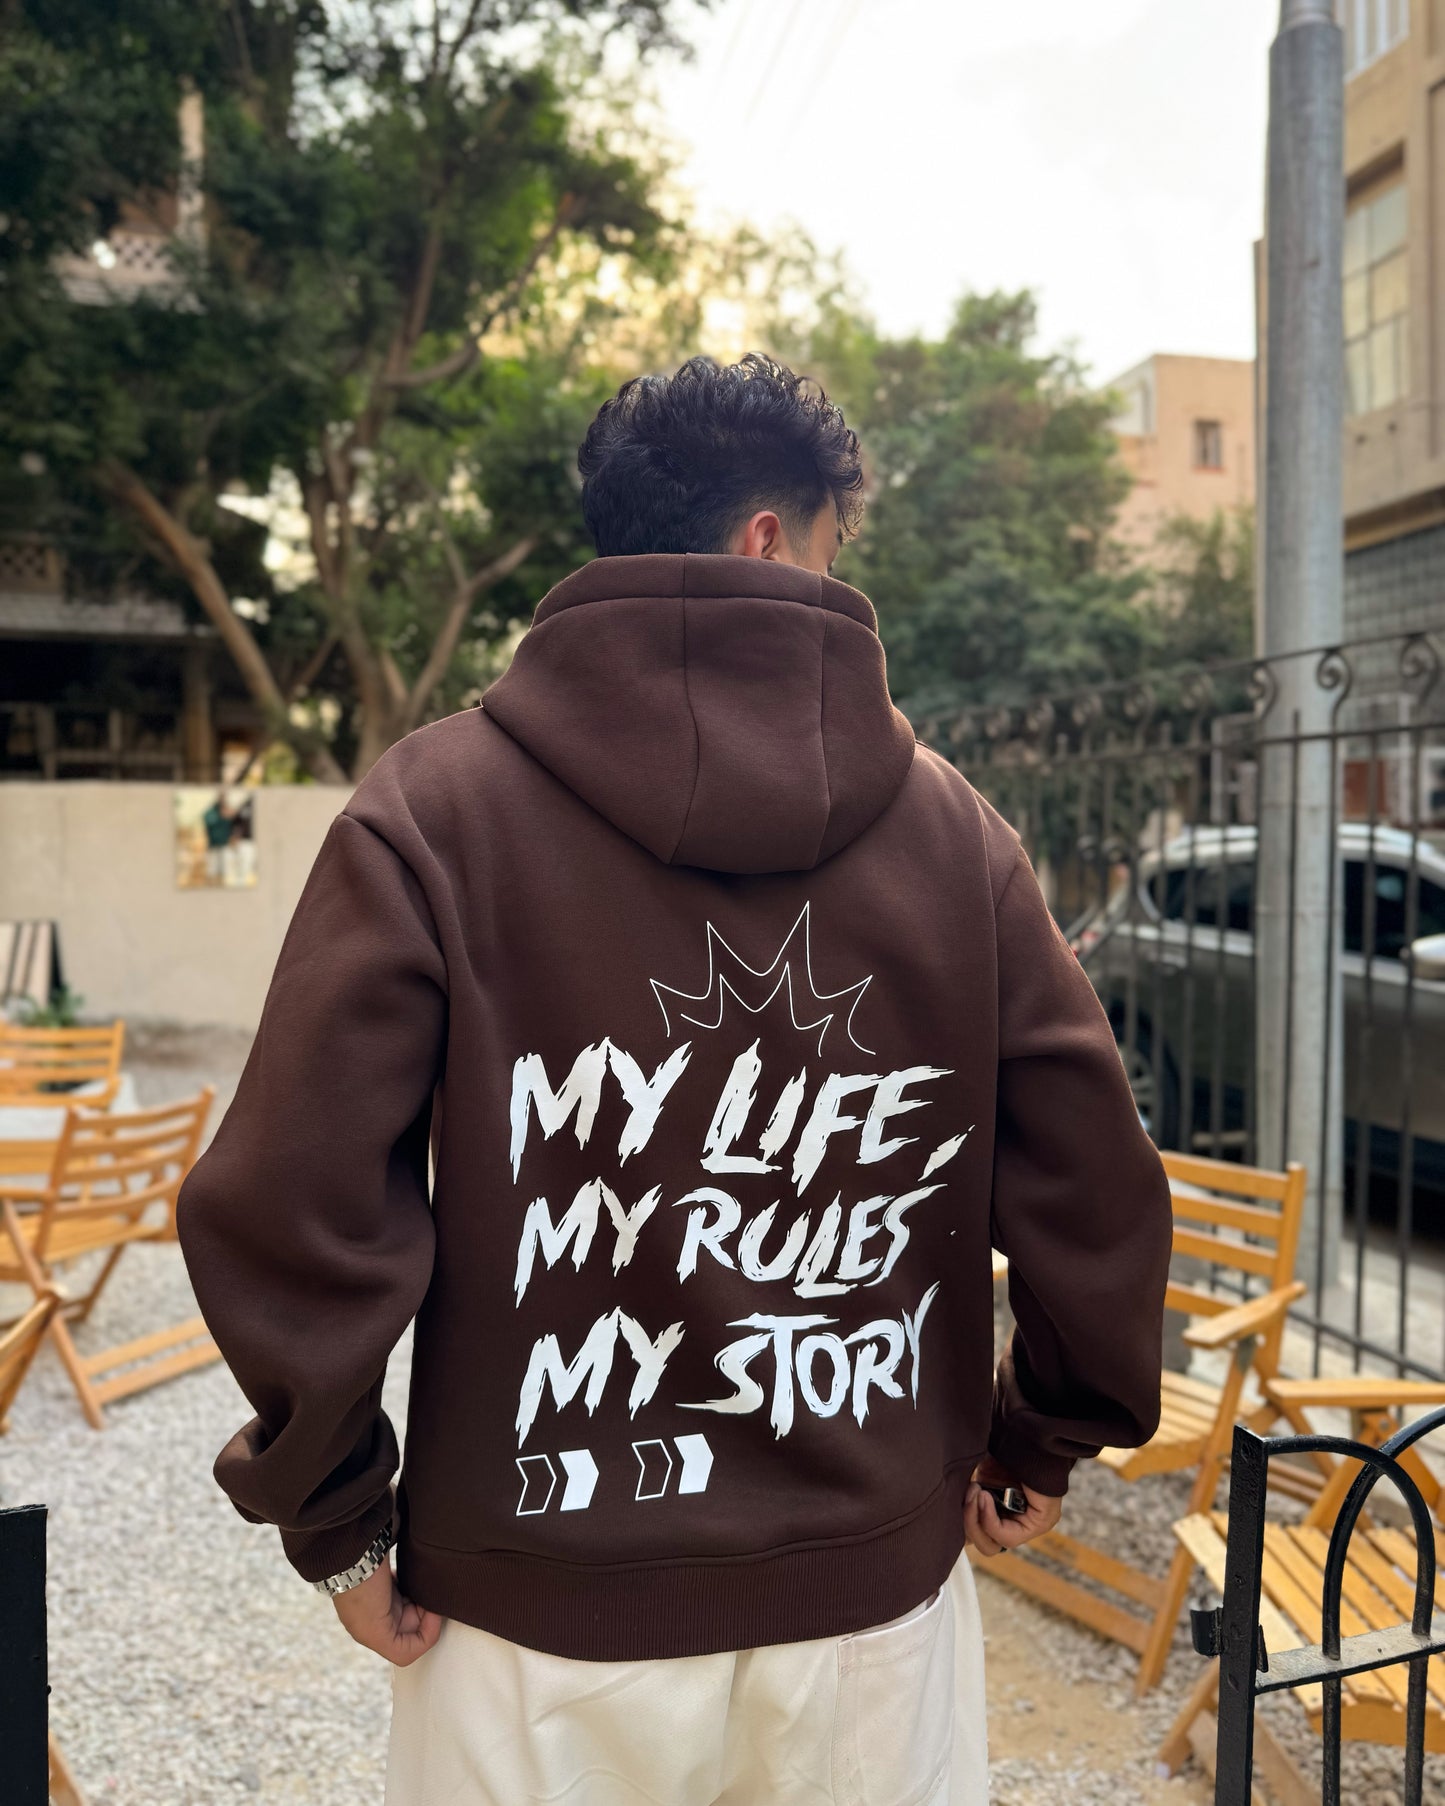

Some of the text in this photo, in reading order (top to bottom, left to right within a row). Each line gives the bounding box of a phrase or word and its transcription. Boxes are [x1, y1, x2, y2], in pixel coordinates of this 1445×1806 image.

[509, 1036, 693, 1185] MY
[513, 1176, 948, 1309] MY RULES
[515, 1280, 940, 1450] MY STORY
